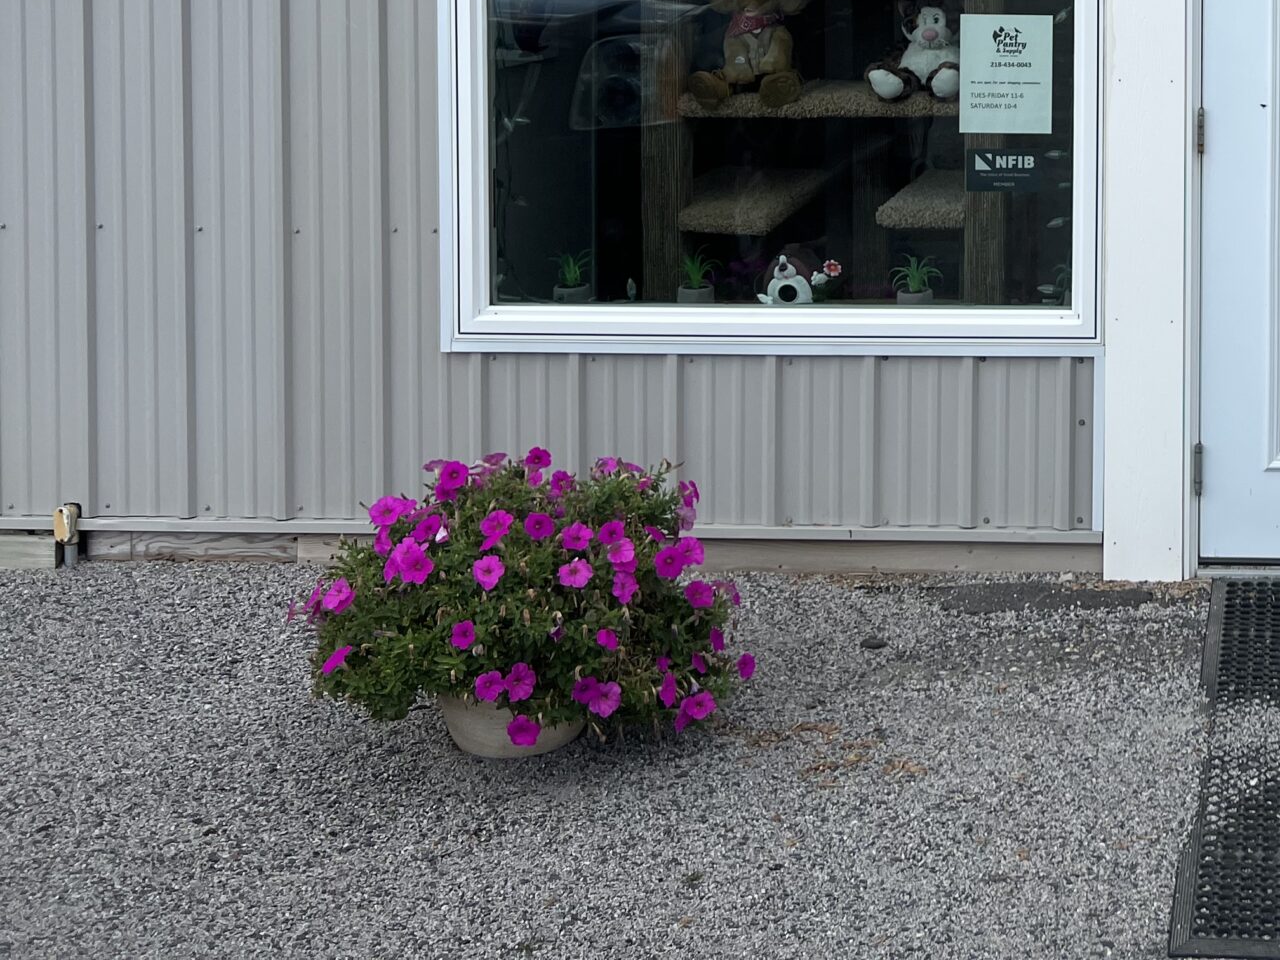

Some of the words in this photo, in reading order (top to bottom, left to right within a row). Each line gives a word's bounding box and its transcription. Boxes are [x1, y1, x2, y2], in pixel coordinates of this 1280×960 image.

[1003, 32, 1018, 41] Pet
[997, 39, 1027, 50] Pantry
[995, 155, 1035, 169] NFIB
